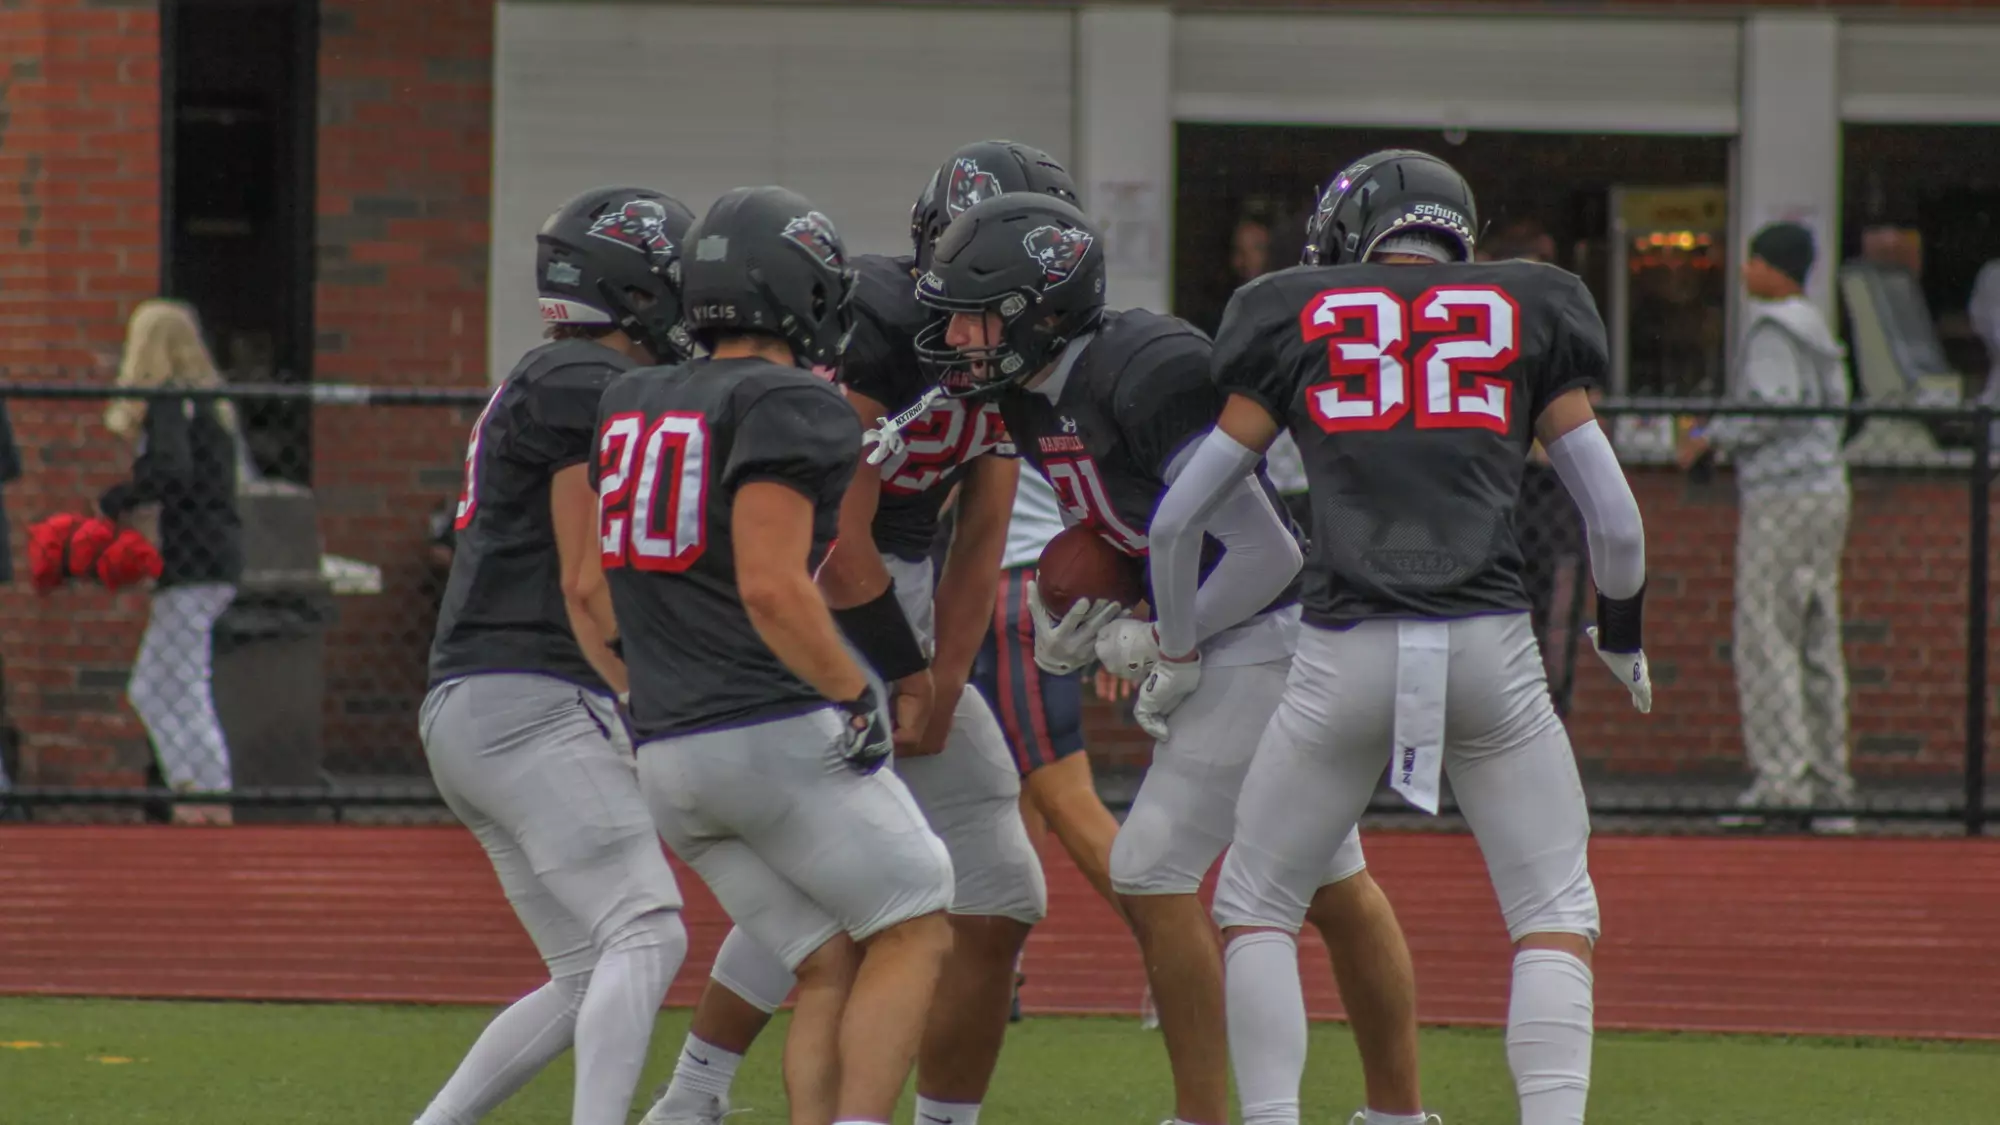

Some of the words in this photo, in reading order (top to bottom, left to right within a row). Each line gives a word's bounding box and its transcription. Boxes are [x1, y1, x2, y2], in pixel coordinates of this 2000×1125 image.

[1413, 203, 1464, 225] schutt
[692, 304, 737, 320] VICIS
[1299, 284, 1521, 436] 32
[894, 402, 923, 428] NXTRND
[599, 410, 712, 573] 20
